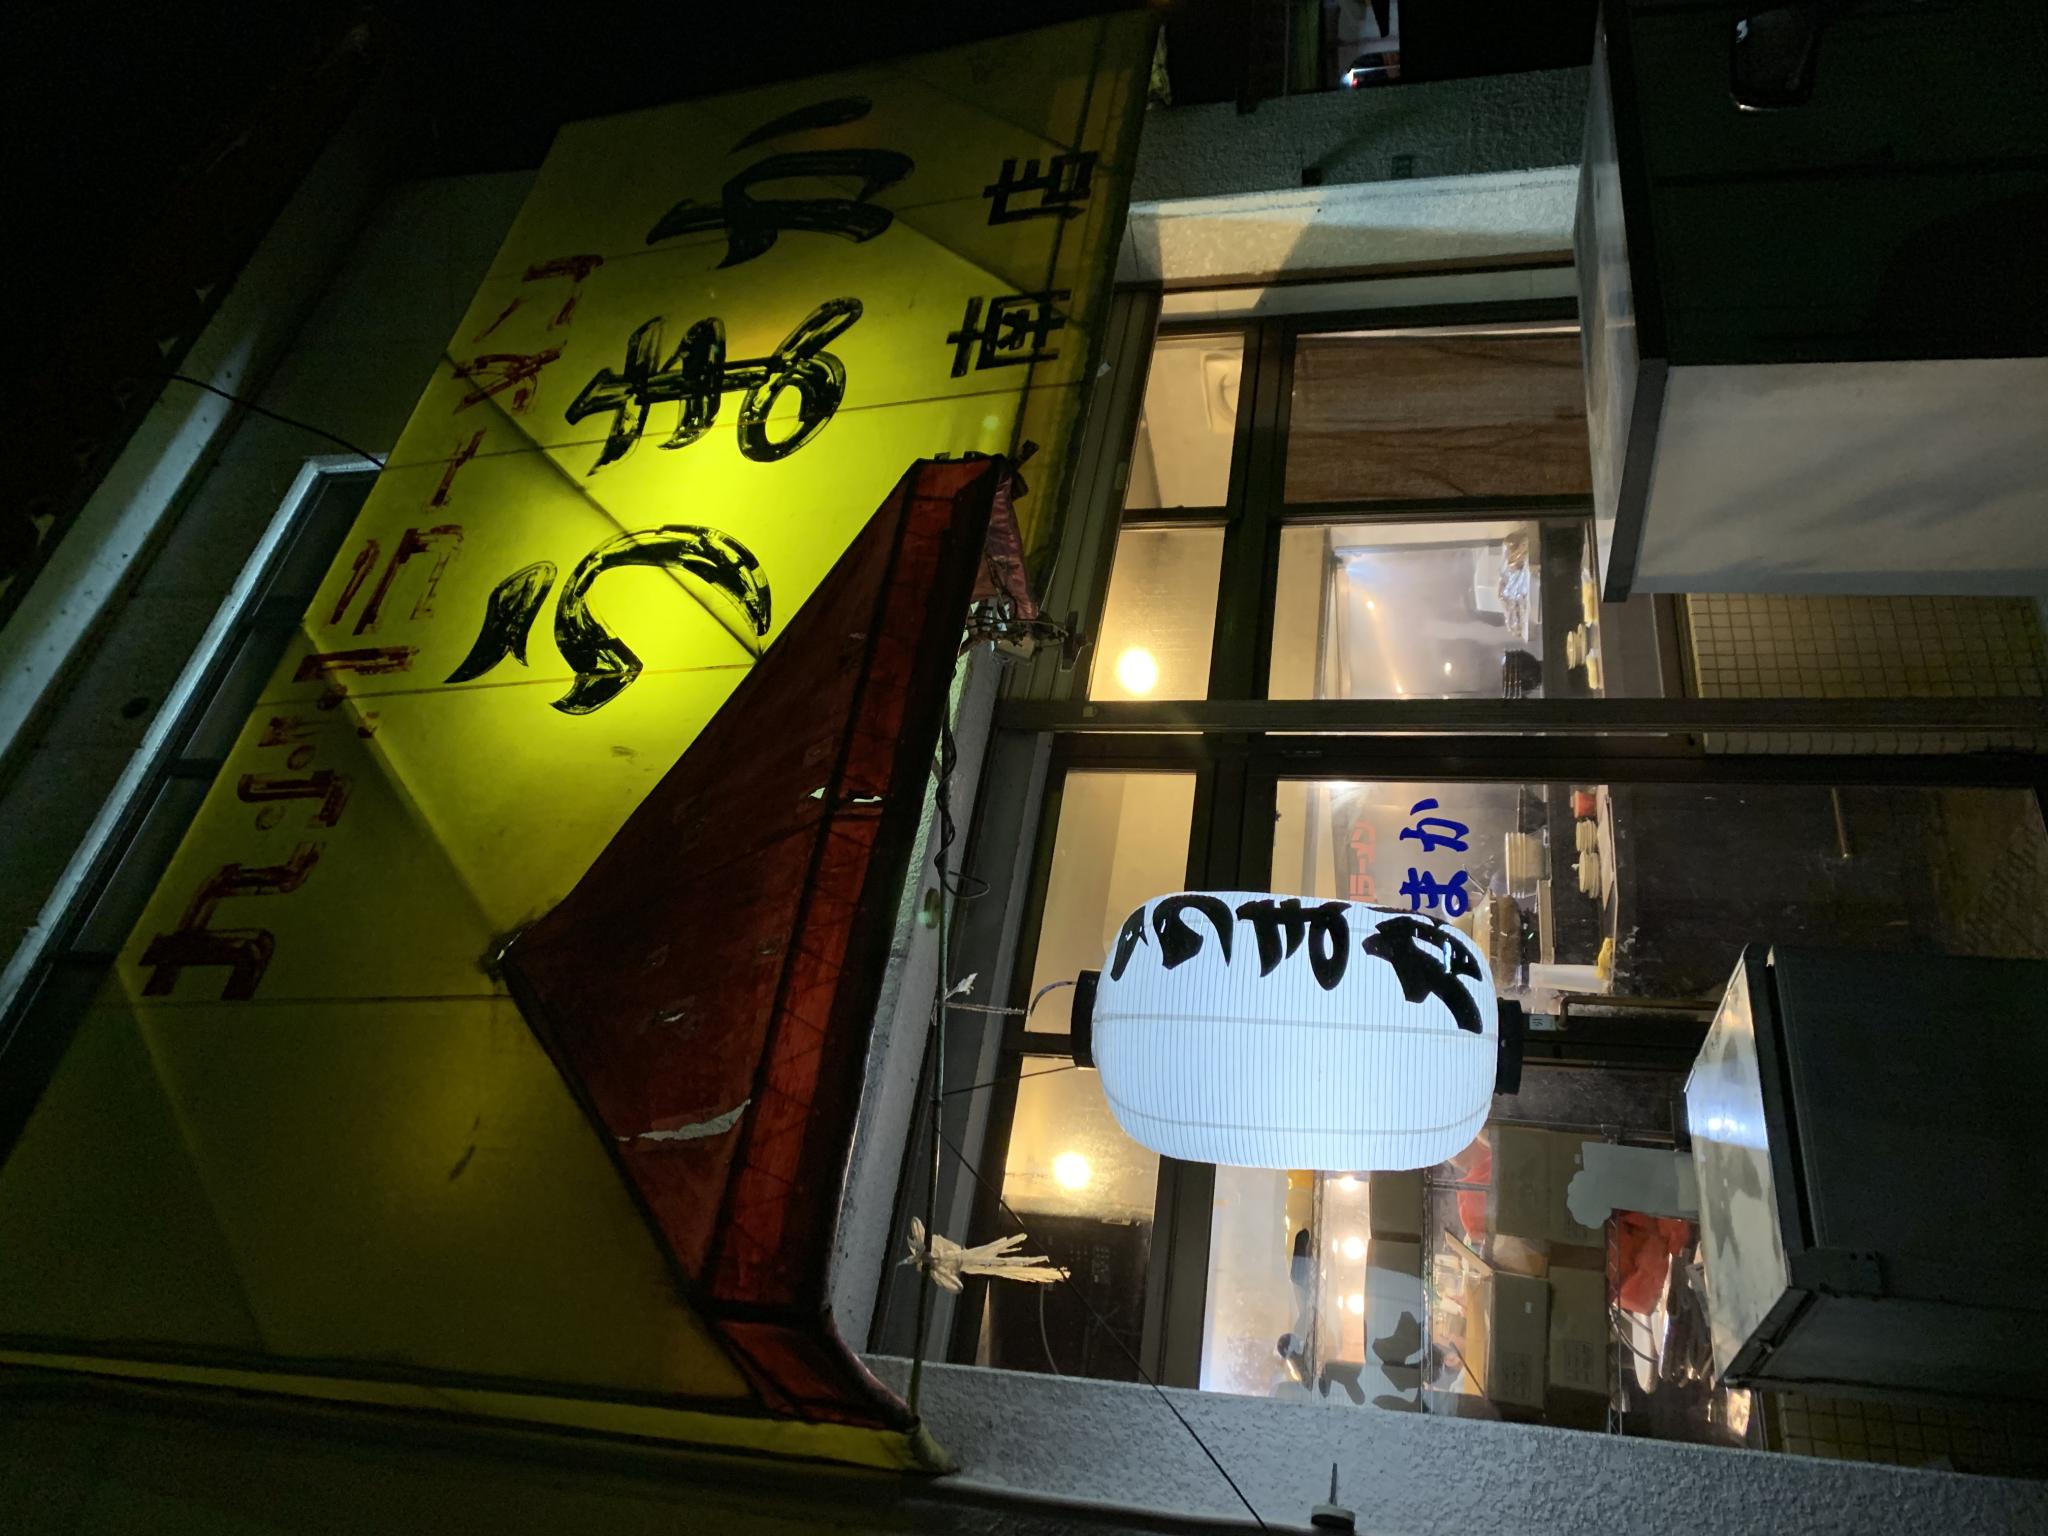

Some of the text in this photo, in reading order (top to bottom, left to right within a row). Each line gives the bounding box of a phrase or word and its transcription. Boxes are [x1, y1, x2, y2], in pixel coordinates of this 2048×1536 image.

[442, 96, 915, 715] うまか
[945, 148, 1098, 497] 南店
[1109, 892, 1483, 1034] うまか
[1349, 817, 1377, 902] ラーメン
